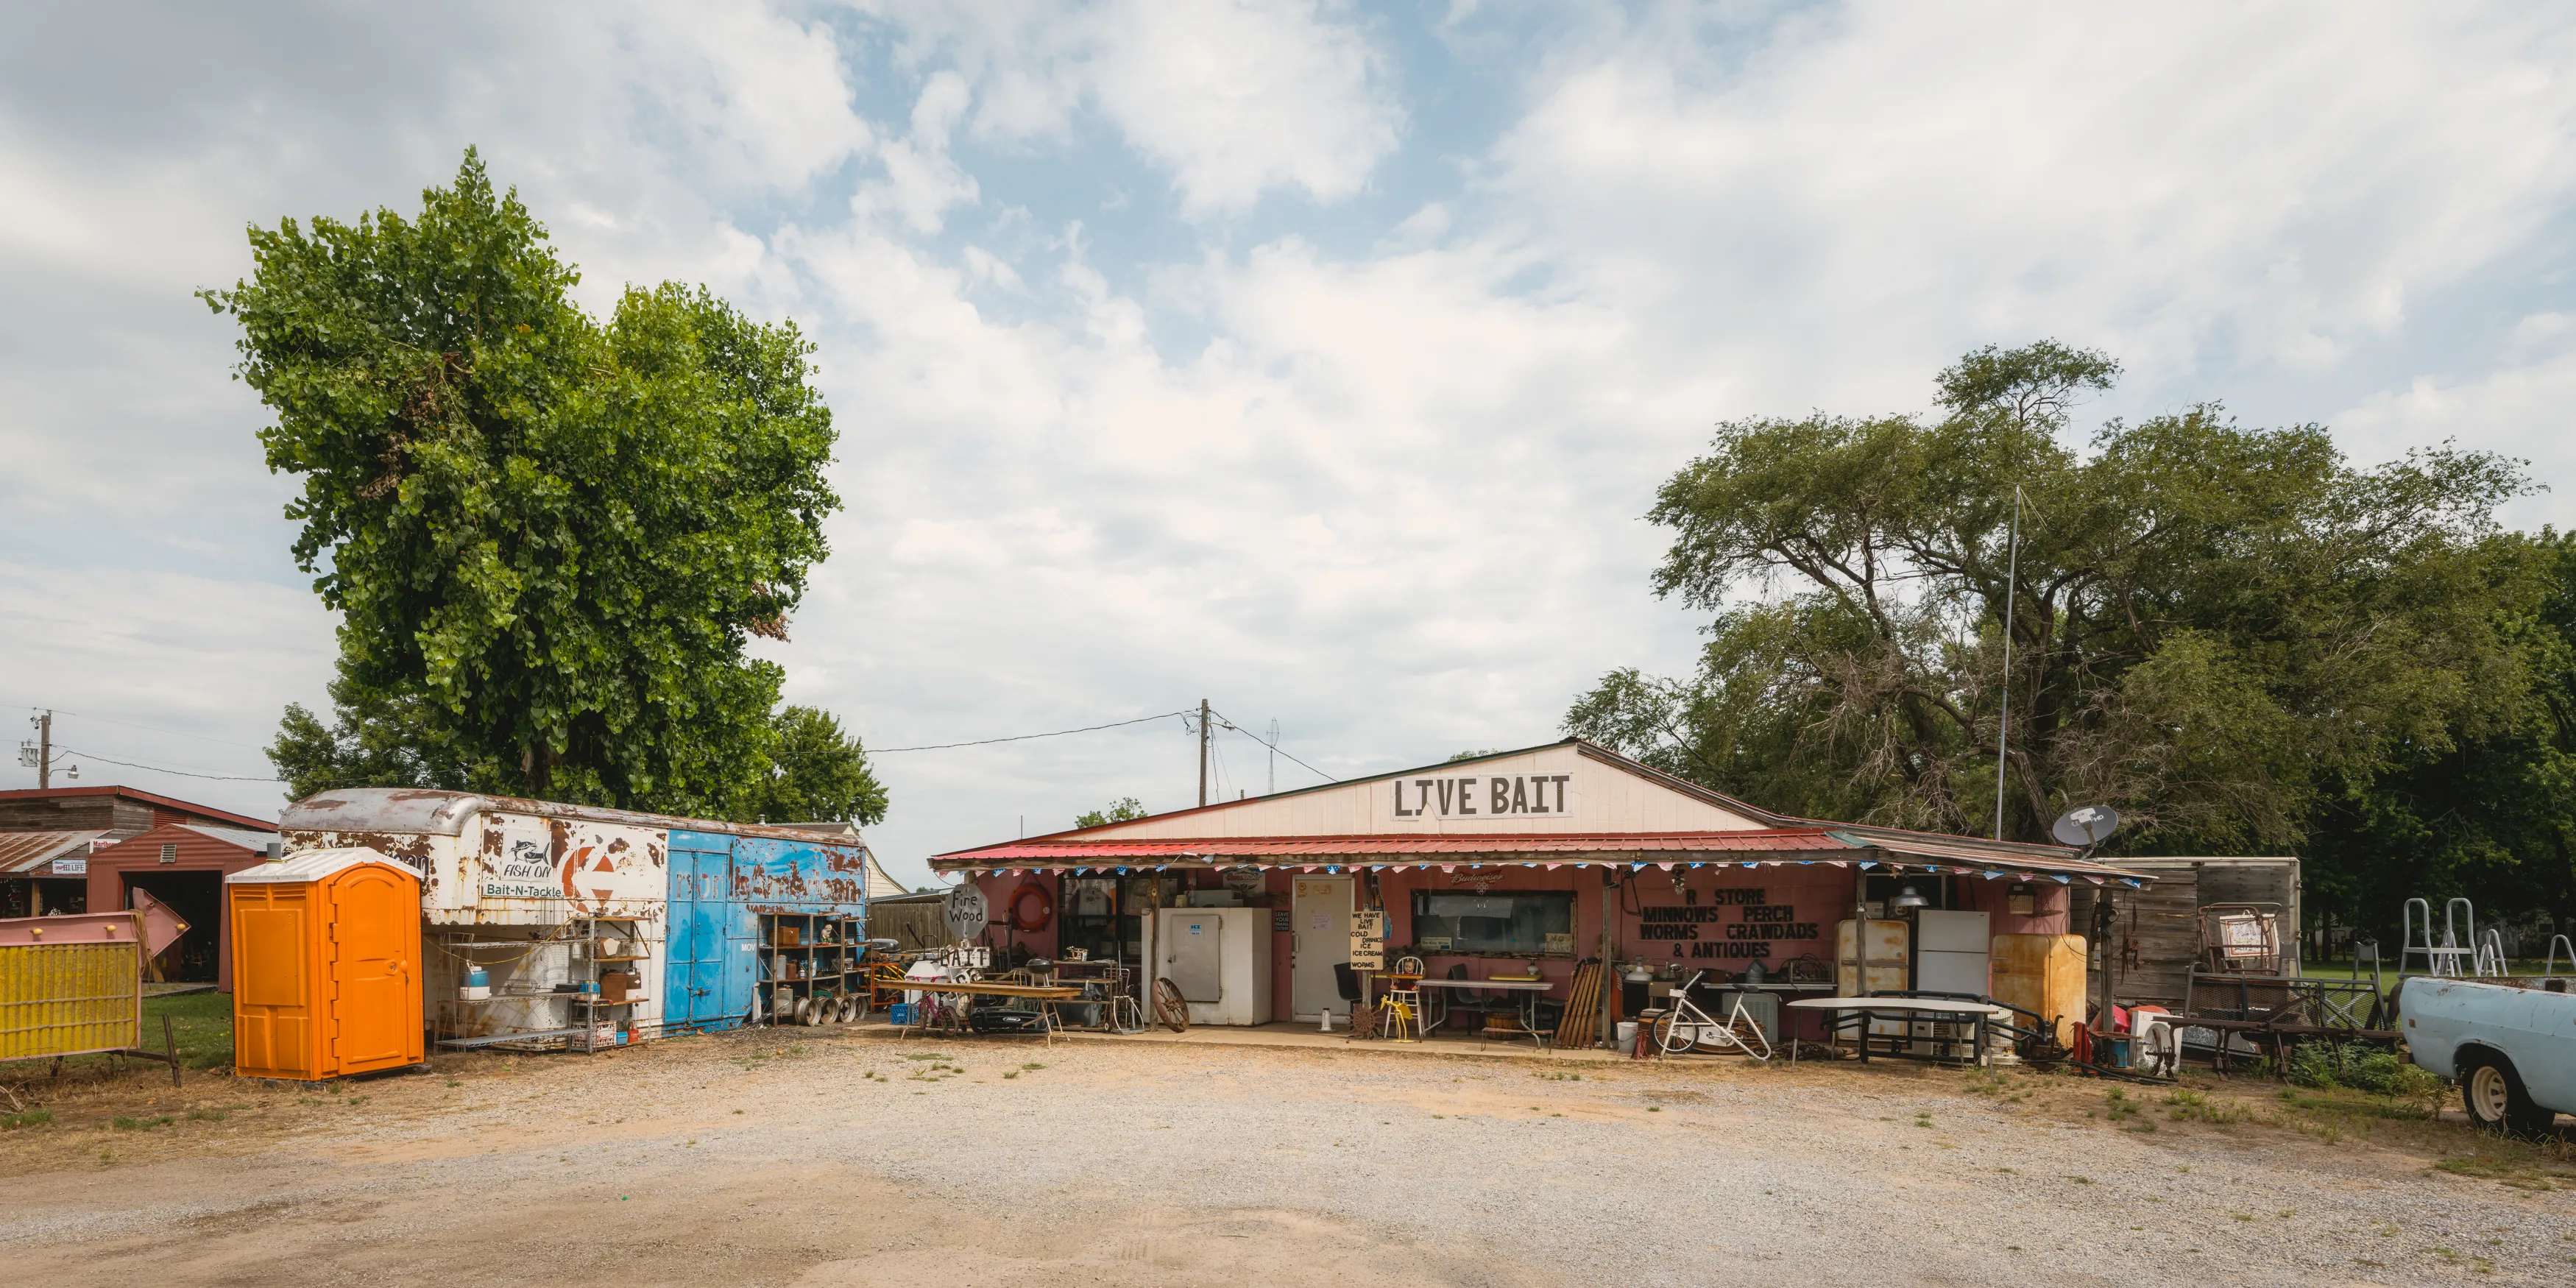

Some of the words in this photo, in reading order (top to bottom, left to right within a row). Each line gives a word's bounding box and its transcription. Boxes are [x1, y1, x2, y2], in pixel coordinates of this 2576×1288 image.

[1395, 778, 1477, 817] LIVE
[1490, 775, 1570, 814] BAIT
[2093, 814, 2104, 822] HD
[503, 864, 532, 877] FISH
[534, 866, 552, 878] ON
[1448, 872, 1504, 883] Budweiser
[486, 884, 562, 897] Bait-N-Tackle
[1686, 888, 1696, 905] R
[1715, 888, 1765, 905] STORE
[952, 890, 977, 909] Fire
[949, 907, 983, 922] Wood
[1643, 906, 1719, 923] MINNOWS
[1744, 905, 1794, 922] PERCH
[1640, 924, 1698, 940] WORMS
[1726, 923, 1819, 940] CRAWDADS
[941, 948, 987, 966] BAIT
[1673, 943, 1684, 958] &
[1691, 941, 1770, 958] ANTIQUES
